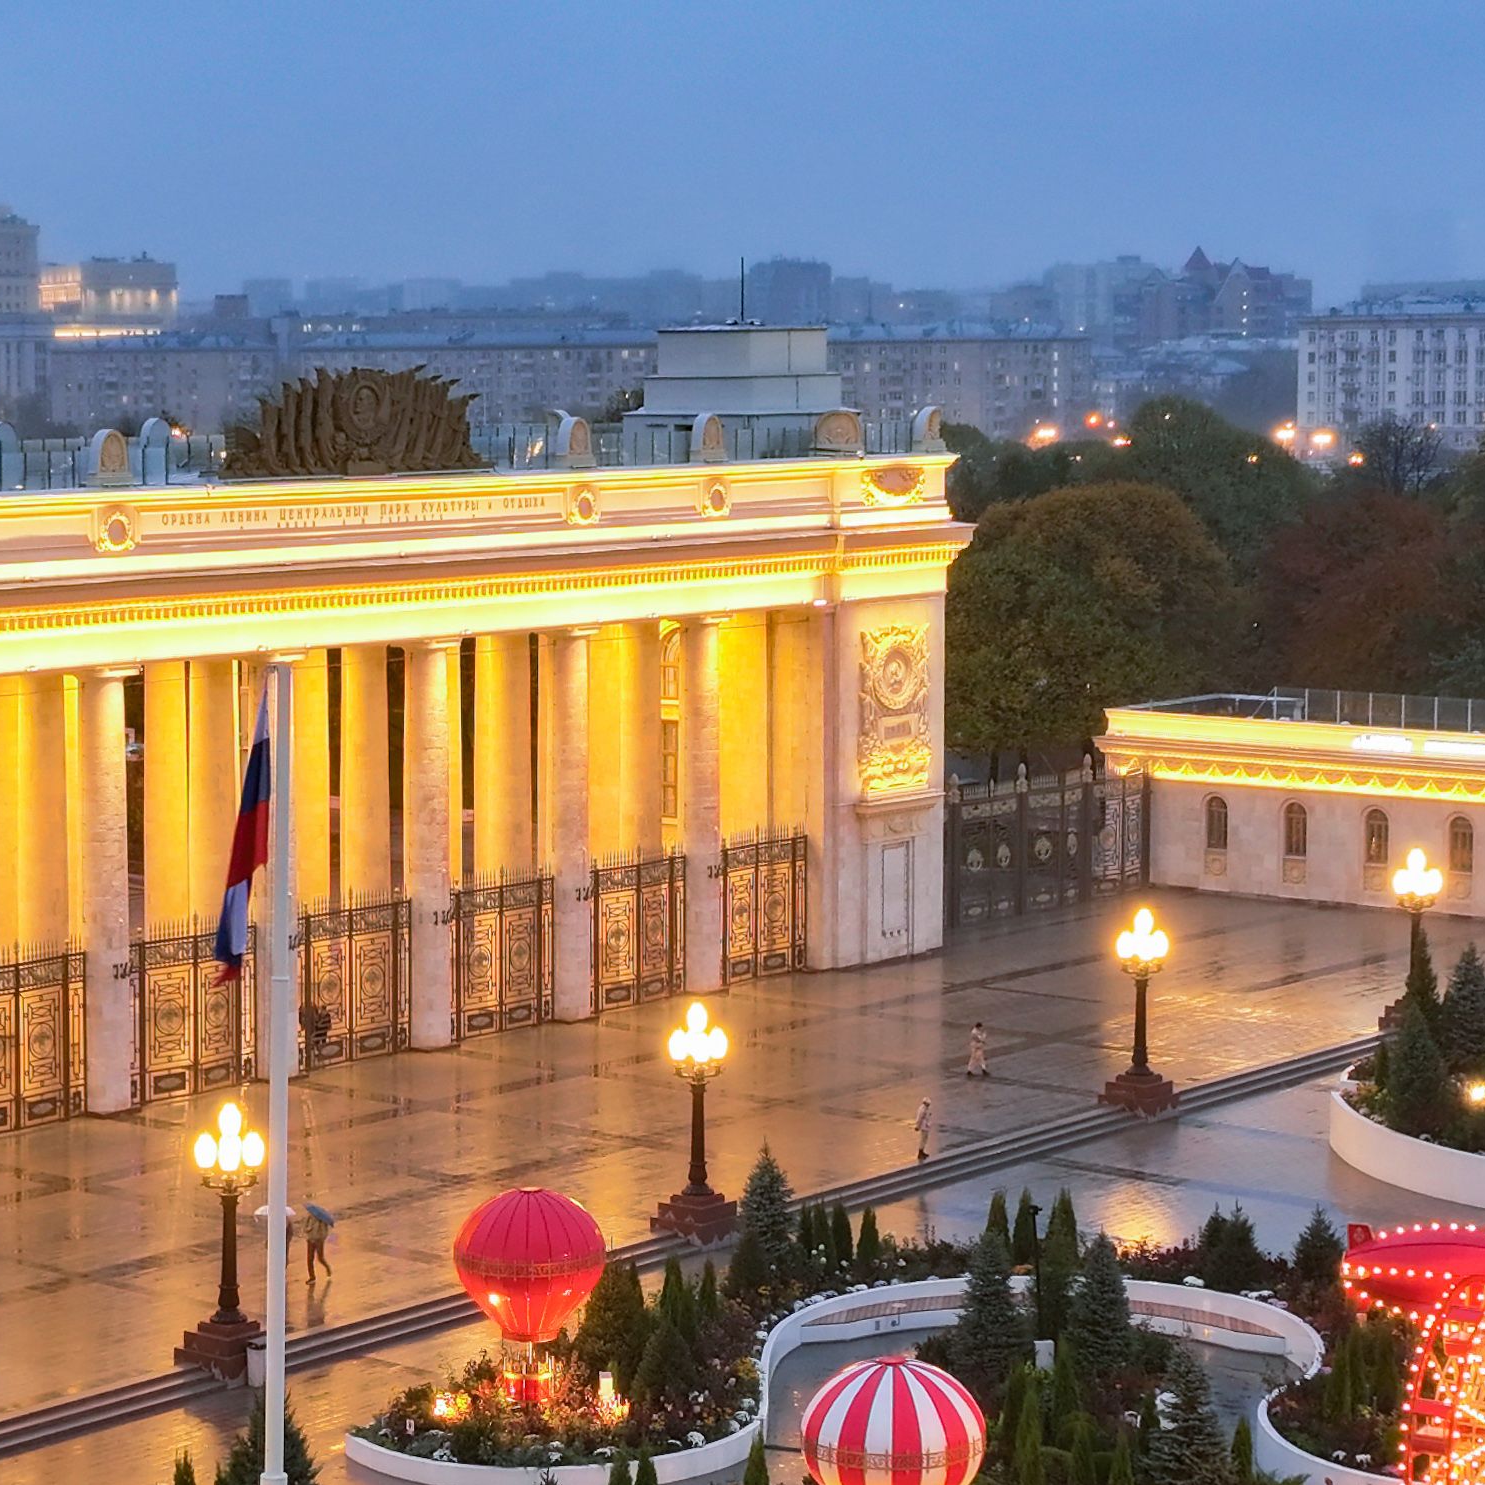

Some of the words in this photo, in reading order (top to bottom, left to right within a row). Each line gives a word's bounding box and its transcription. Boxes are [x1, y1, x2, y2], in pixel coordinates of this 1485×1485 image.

[161, 512, 210, 526] ОРДЕНА
[221, 509, 268, 523] ЛЕНИНА
[380, 503, 410, 515] ПАРК
[421, 500, 479, 514] КУЛЬТУРЫ
[503, 497, 545, 509] ОТДЫХА
